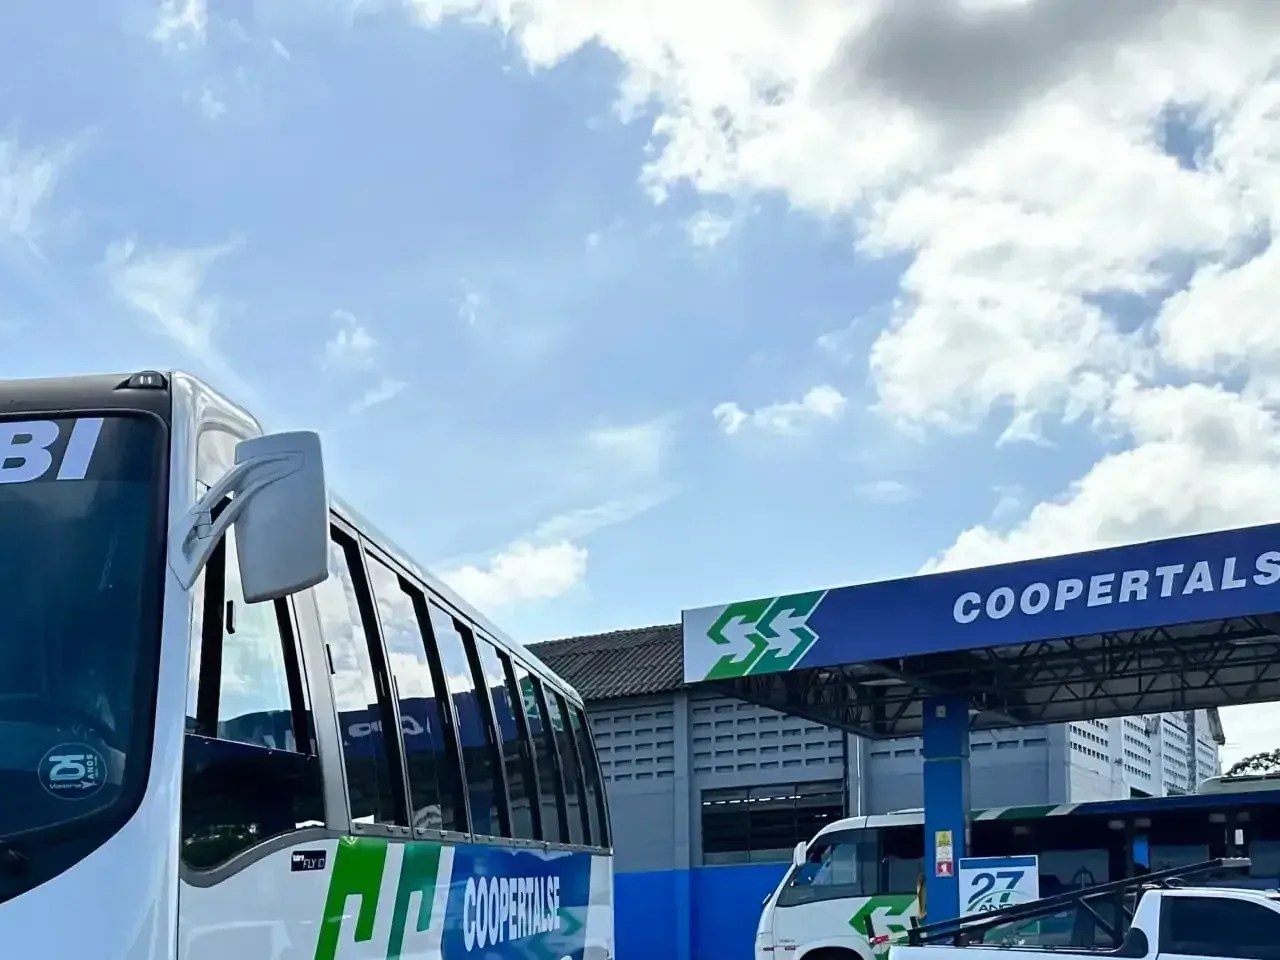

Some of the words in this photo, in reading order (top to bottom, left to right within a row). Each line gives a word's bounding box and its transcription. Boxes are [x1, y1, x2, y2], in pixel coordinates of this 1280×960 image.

[952, 550, 1280, 624] COOPERTALS
[463, 876, 560, 952] COOPERTALSE
[968, 871, 1024, 905] 27
